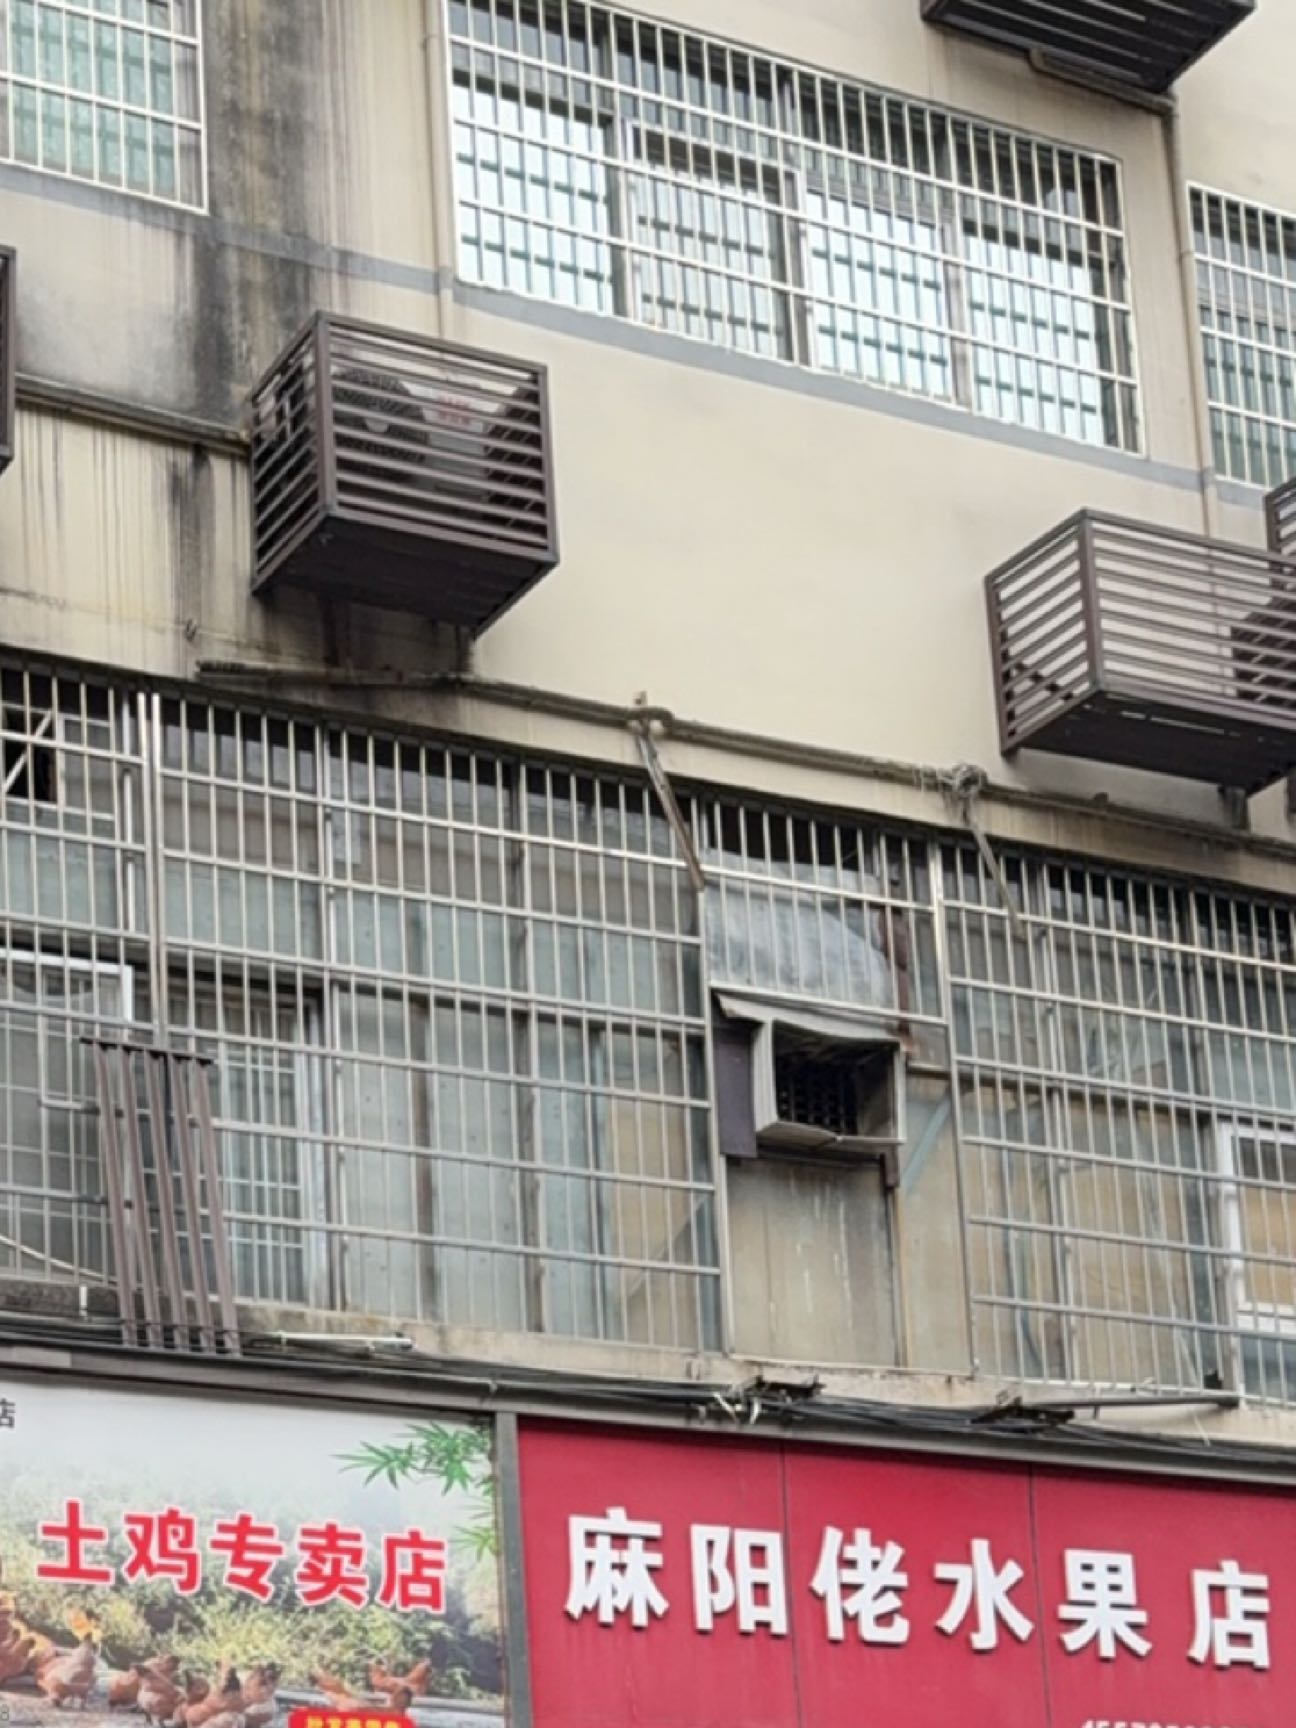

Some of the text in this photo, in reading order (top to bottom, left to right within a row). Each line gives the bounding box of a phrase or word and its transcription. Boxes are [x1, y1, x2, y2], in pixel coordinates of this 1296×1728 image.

[34, 1498, 447, 1614] 土鸡专卖店
[564, 1506, 1272, 1671] 麻阳佬水果店
